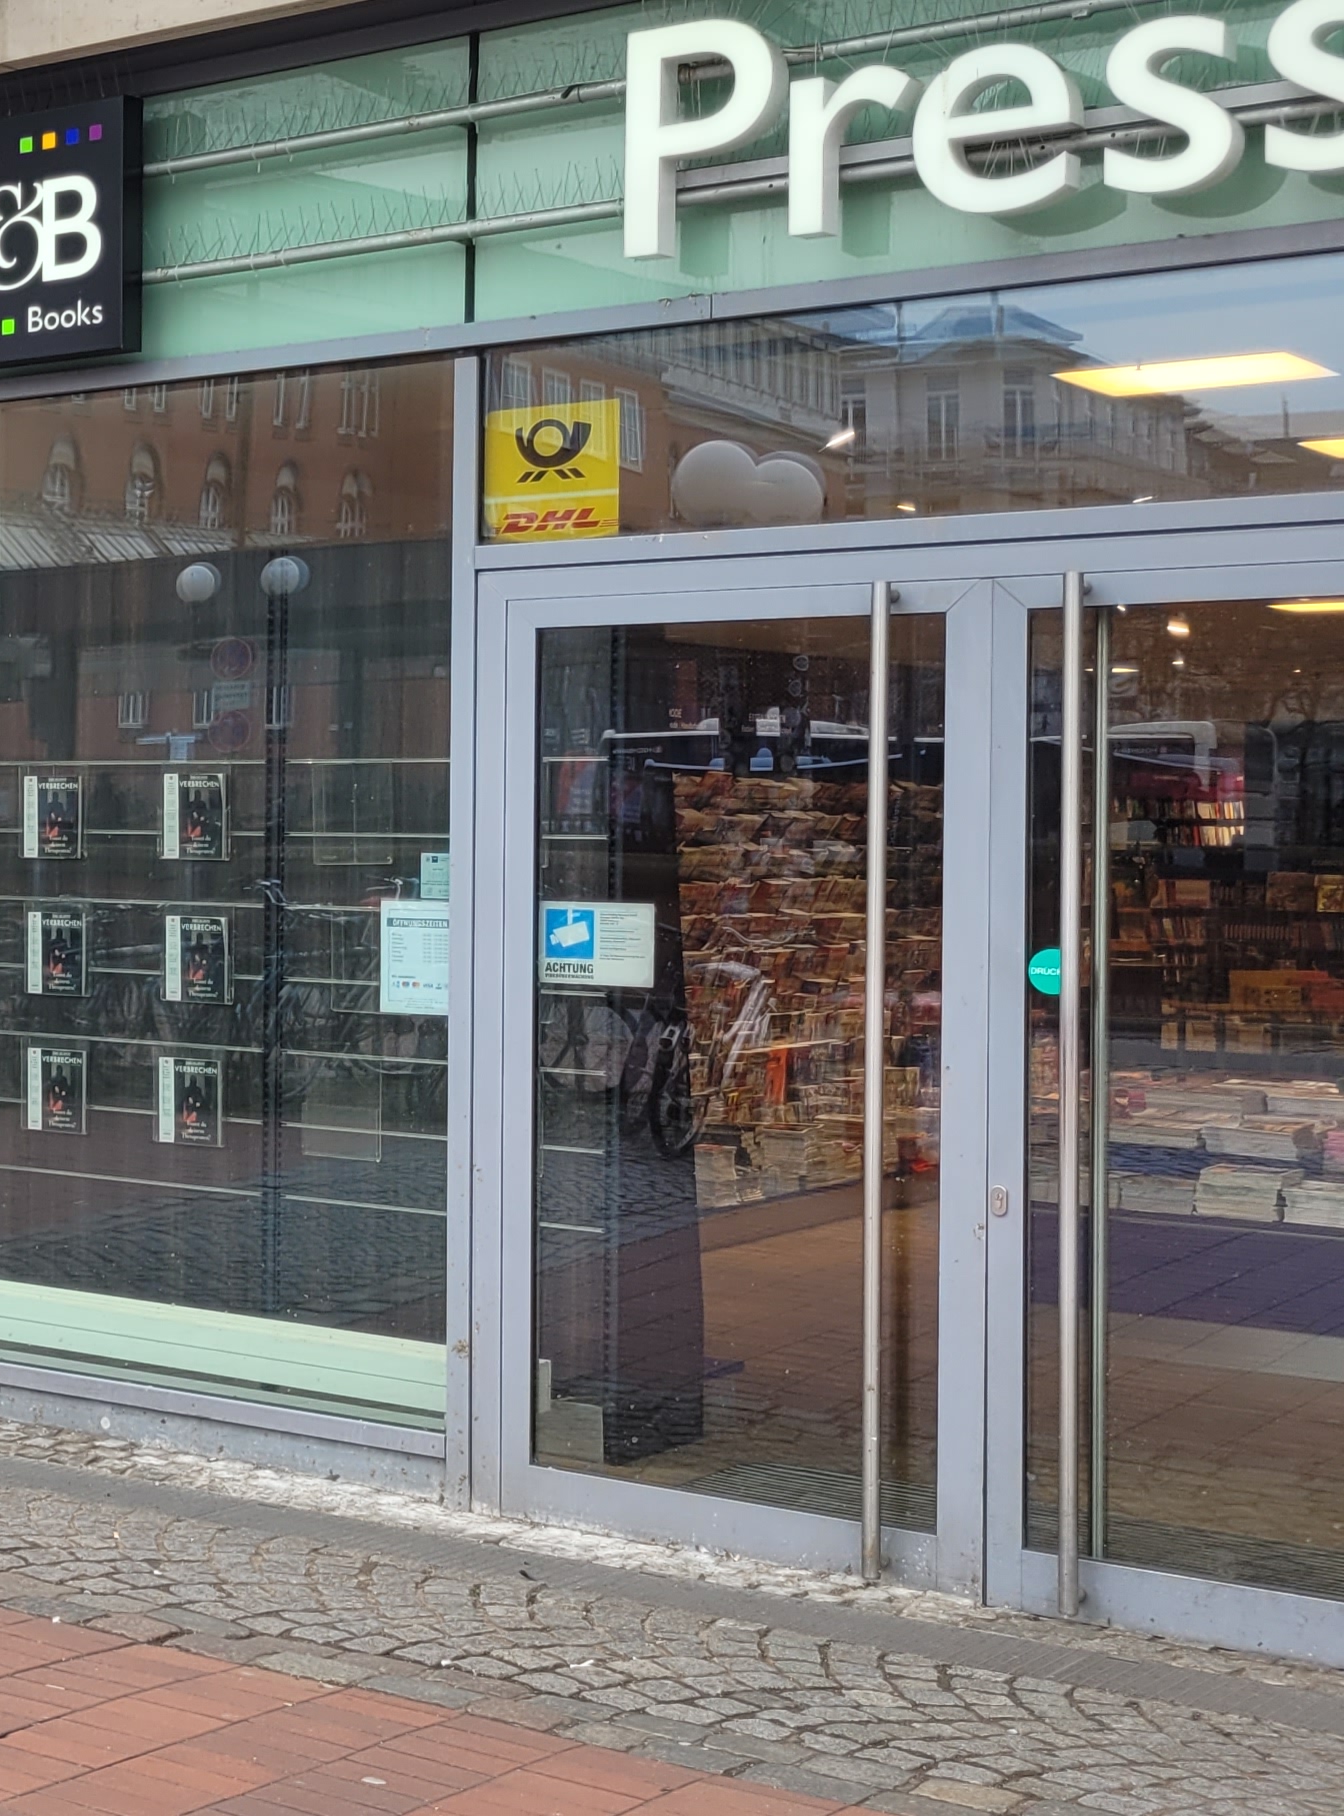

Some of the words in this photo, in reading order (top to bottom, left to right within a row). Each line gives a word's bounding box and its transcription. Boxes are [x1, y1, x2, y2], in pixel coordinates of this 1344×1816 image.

[27, 299, 104, 333] Books
[500, 507, 601, 535] DHL
[545, 962, 594, 974] ACHTUNG
